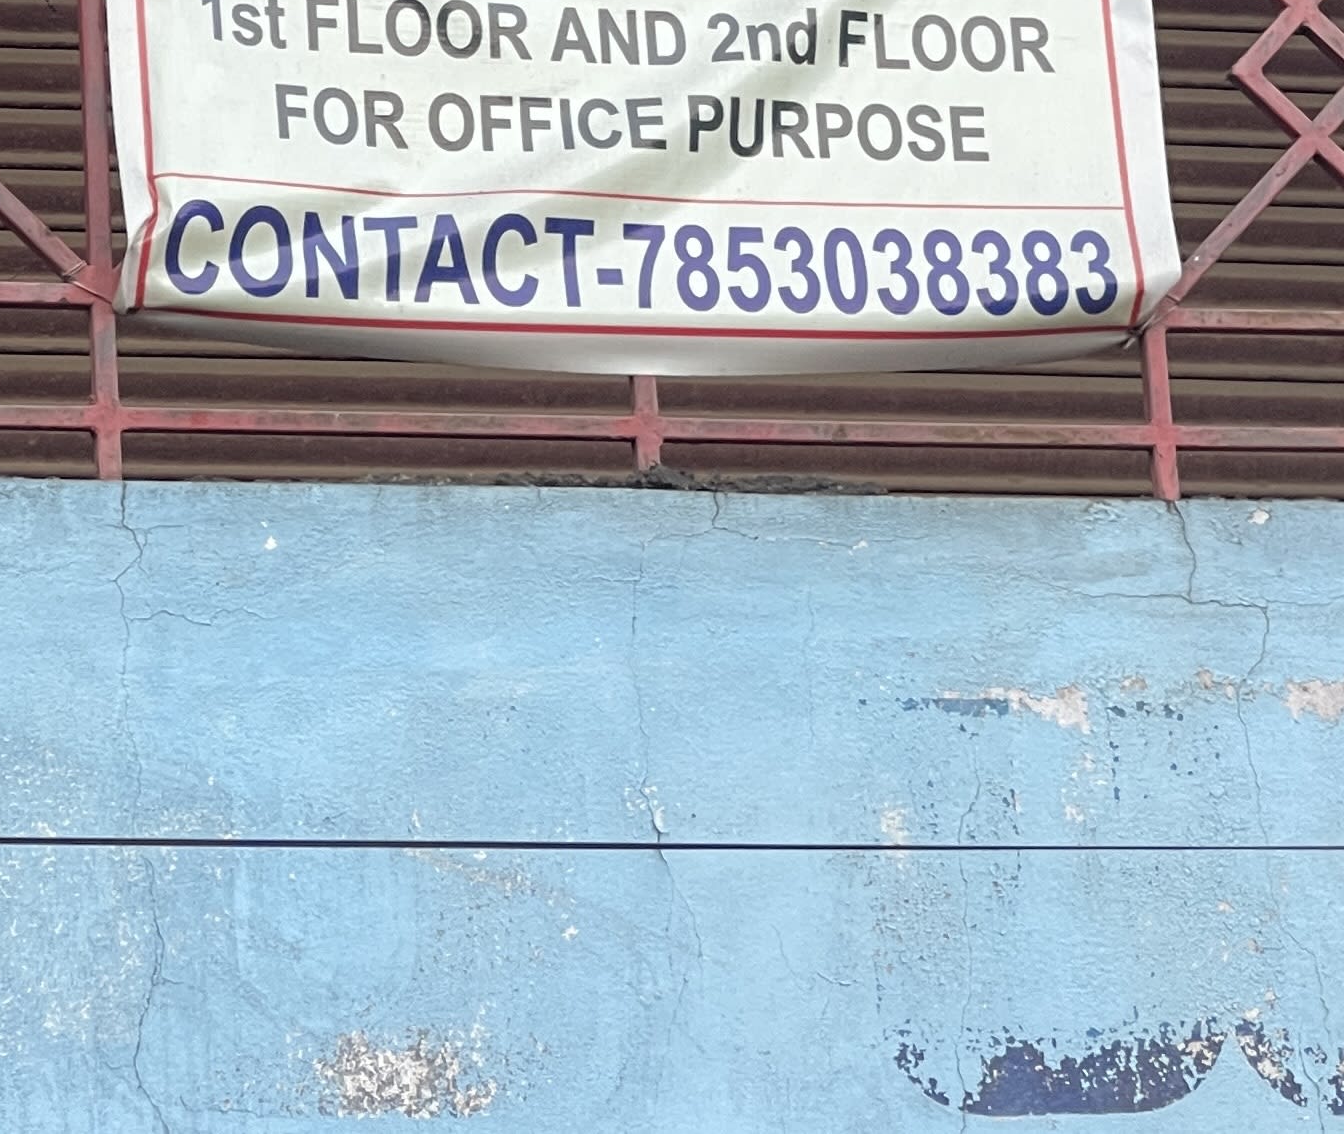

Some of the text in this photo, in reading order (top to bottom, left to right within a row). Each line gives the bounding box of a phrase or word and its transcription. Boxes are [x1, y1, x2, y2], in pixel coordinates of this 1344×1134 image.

[552, 8, 685, 64] AND
[709, 9, 817, 65] 2nd
[839, 10, 1053, 72] FLOOR
[276, 85, 988, 161] FOR OFFICE PURPOSE
